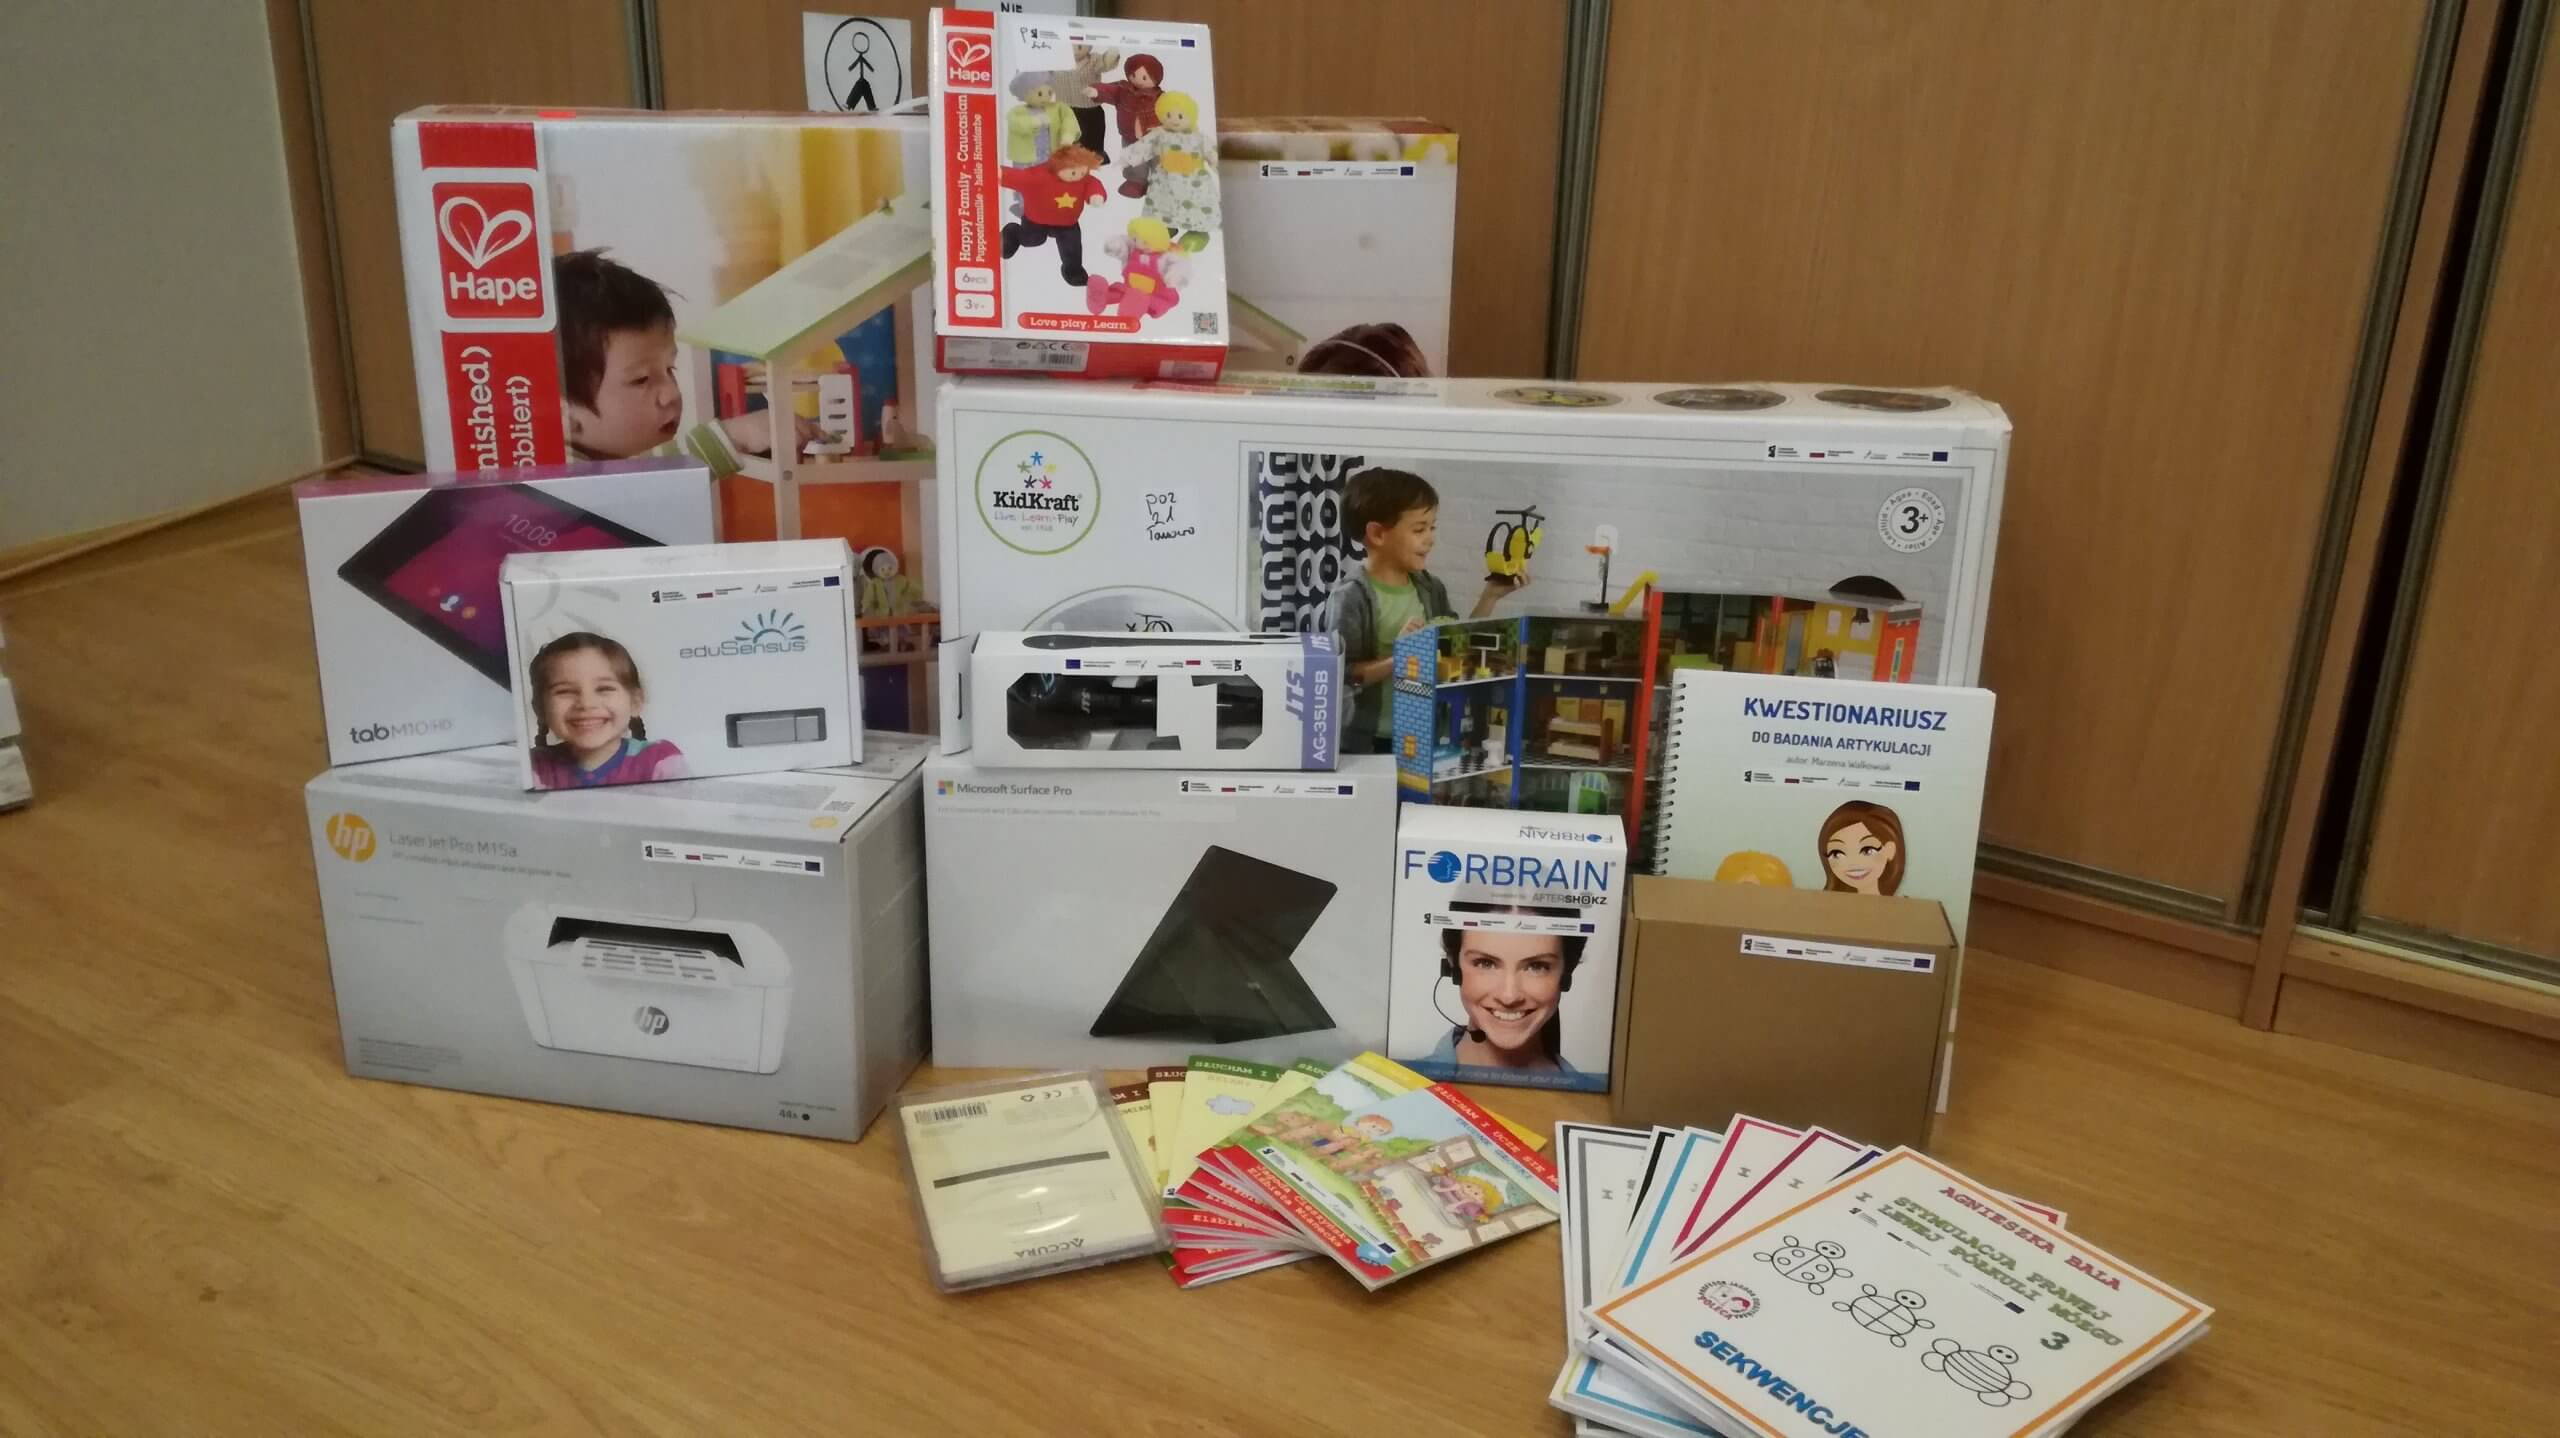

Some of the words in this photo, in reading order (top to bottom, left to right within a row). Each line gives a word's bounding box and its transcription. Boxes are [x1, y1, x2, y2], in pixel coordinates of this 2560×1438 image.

[950, 67, 991, 83] Hape
[957, 94, 969, 162] Caucasian
[958, 172, 972, 217] Family
[959, 219, 972, 262] Happy
[449, 271, 537, 307] Hape
[1030, 316, 1058, 328] Love
[993, 490, 1080, 511] KidKraft
[680, 639, 807, 659] eduSensus
[1312, 669, 1329, 763] AG-35USB
[1743, 696, 1948, 732] KWESTIONARIUSZ
[1752, 730, 1770, 744] DO
[1774, 732, 1833, 749] BADANIA
[1836, 736, 1932, 757] ARTYKULACJI
[957, 783, 1008, 794] Microsoft
[1010, 784, 1050, 795] Surface
[1053, 785, 1073, 796] Pro
[329, 813, 372, 863] hp
[1404, 850, 1609, 891] FORBRAIN
[636, 1006, 669, 1035] hp
[1938, 1186, 2056, 1255] AGNIESZKA
[1877, 1204, 1944, 1243] LEWEJ
[1949, 1244, 2044, 1302] PÓŁKULI
[2047, 1302, 2124, 1347] MÓZGU
[1893, 1196, 2018, 1272] STYMULACJA
[2026, 1271, 2112, 1322] PRAWEJ
[2040, 1330, 2070, 1351] 3
